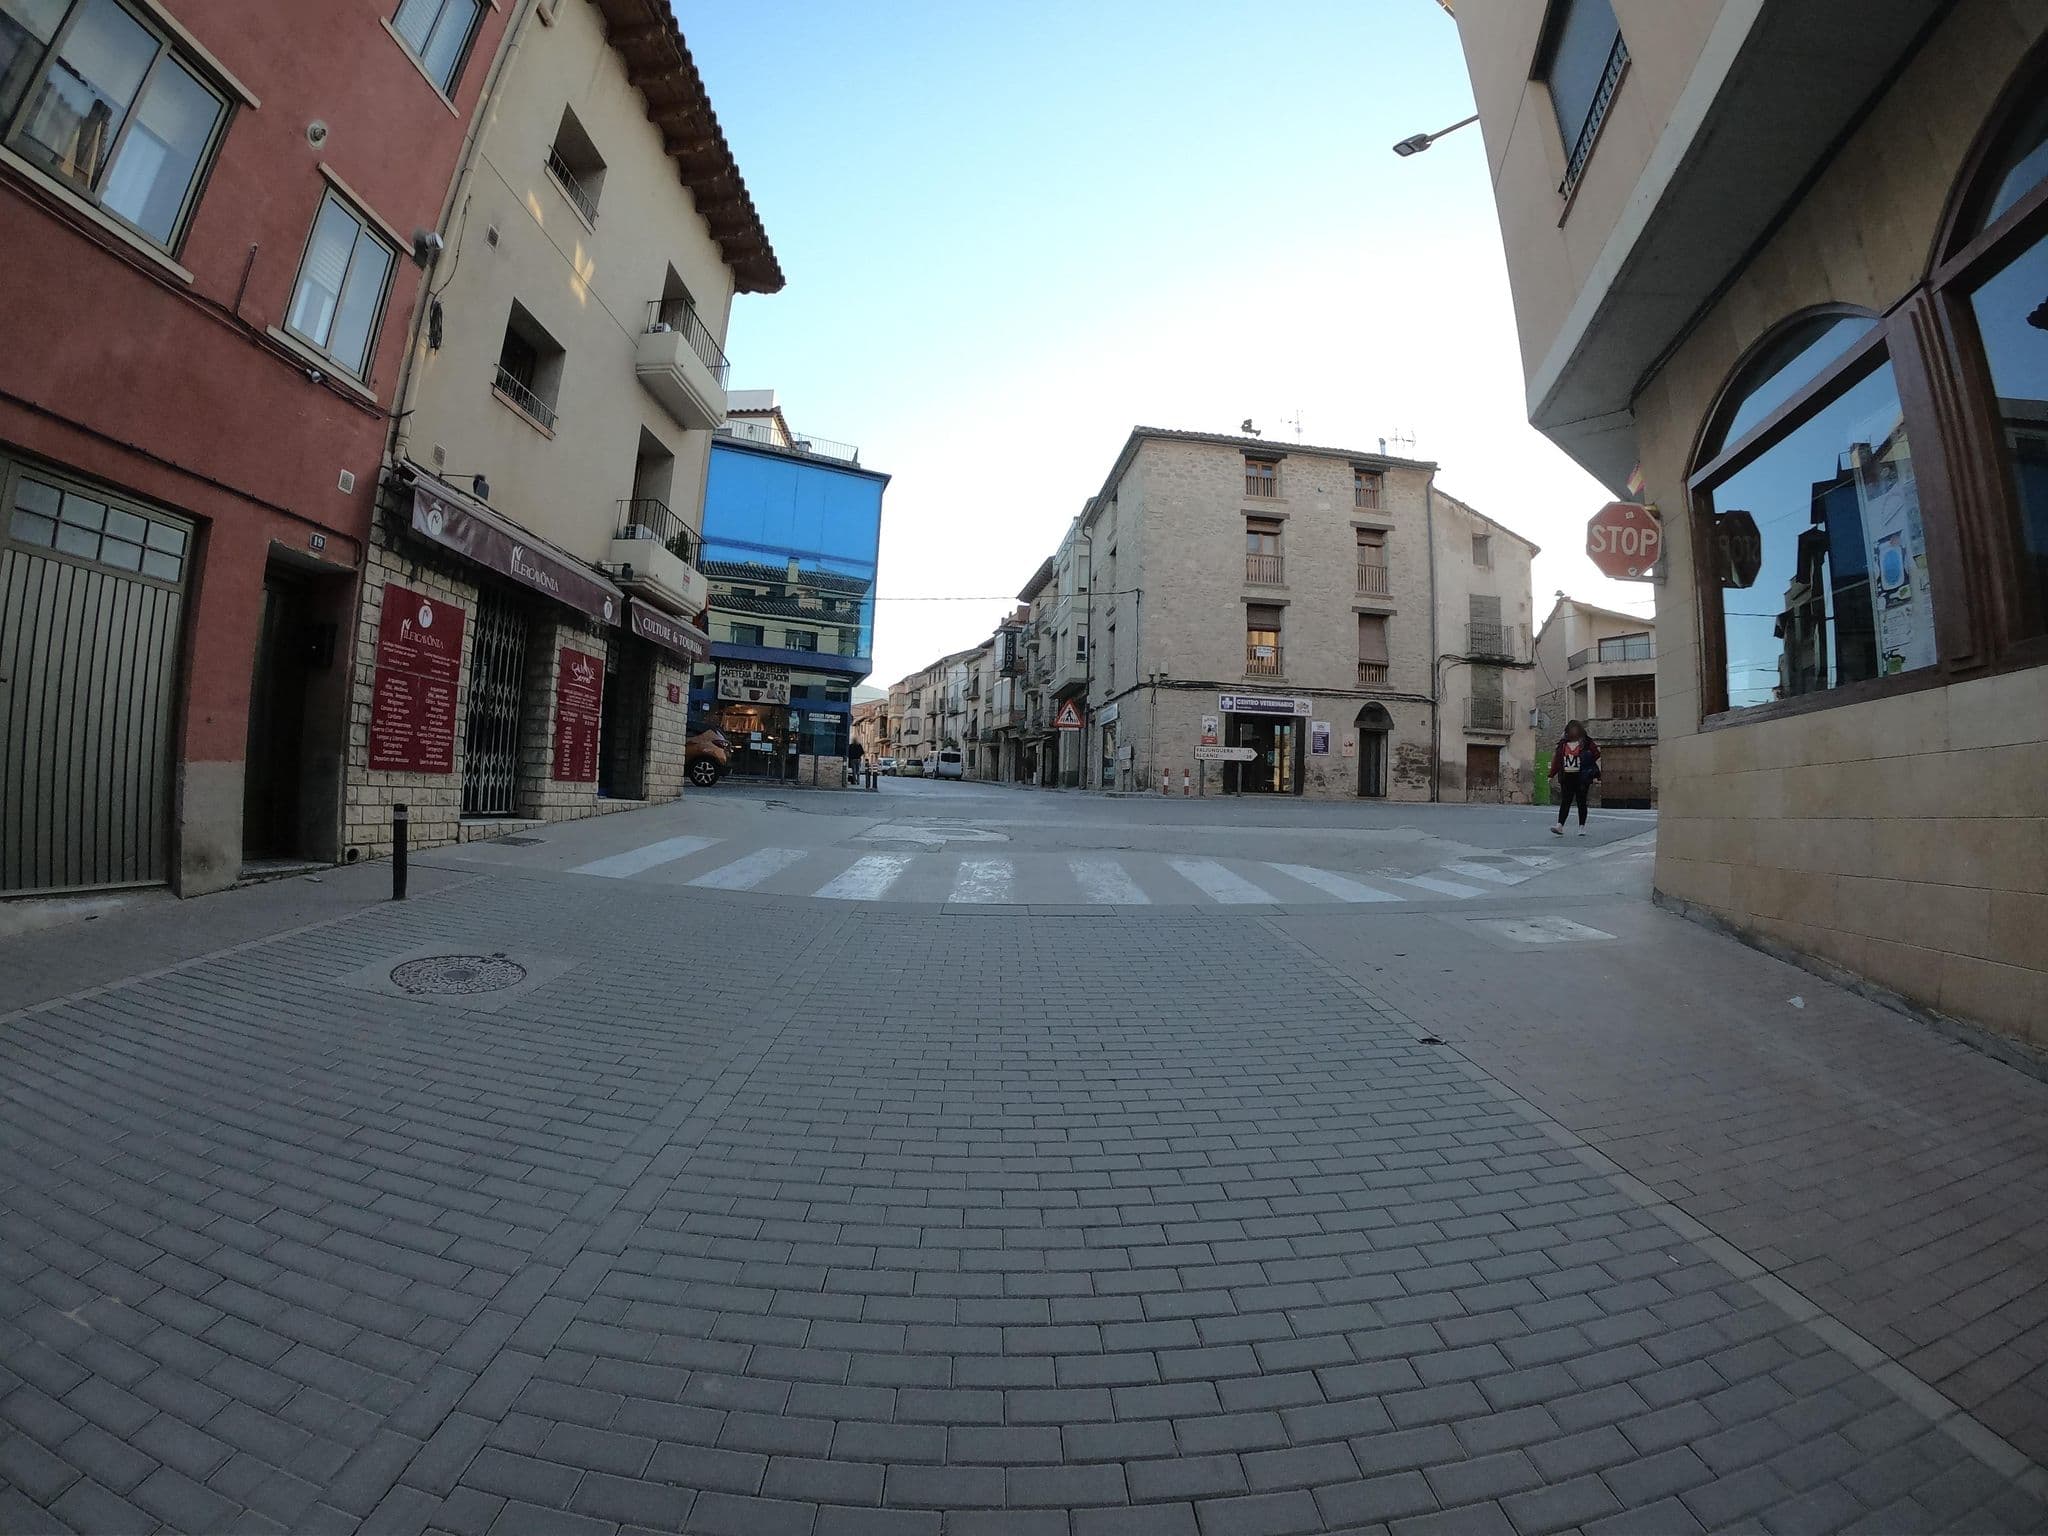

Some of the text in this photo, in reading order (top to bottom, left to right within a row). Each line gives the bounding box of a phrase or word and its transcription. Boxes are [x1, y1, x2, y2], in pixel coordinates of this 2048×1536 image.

[314, 536, 323, 547] 19
[1591, 524, 1658, 556] STOP
[643, 617, 703, 655] CULTURE & TOURISM
[1260, 700, 1294, 708] VETERINARIO
[1564, 756, 1578, 768] M
